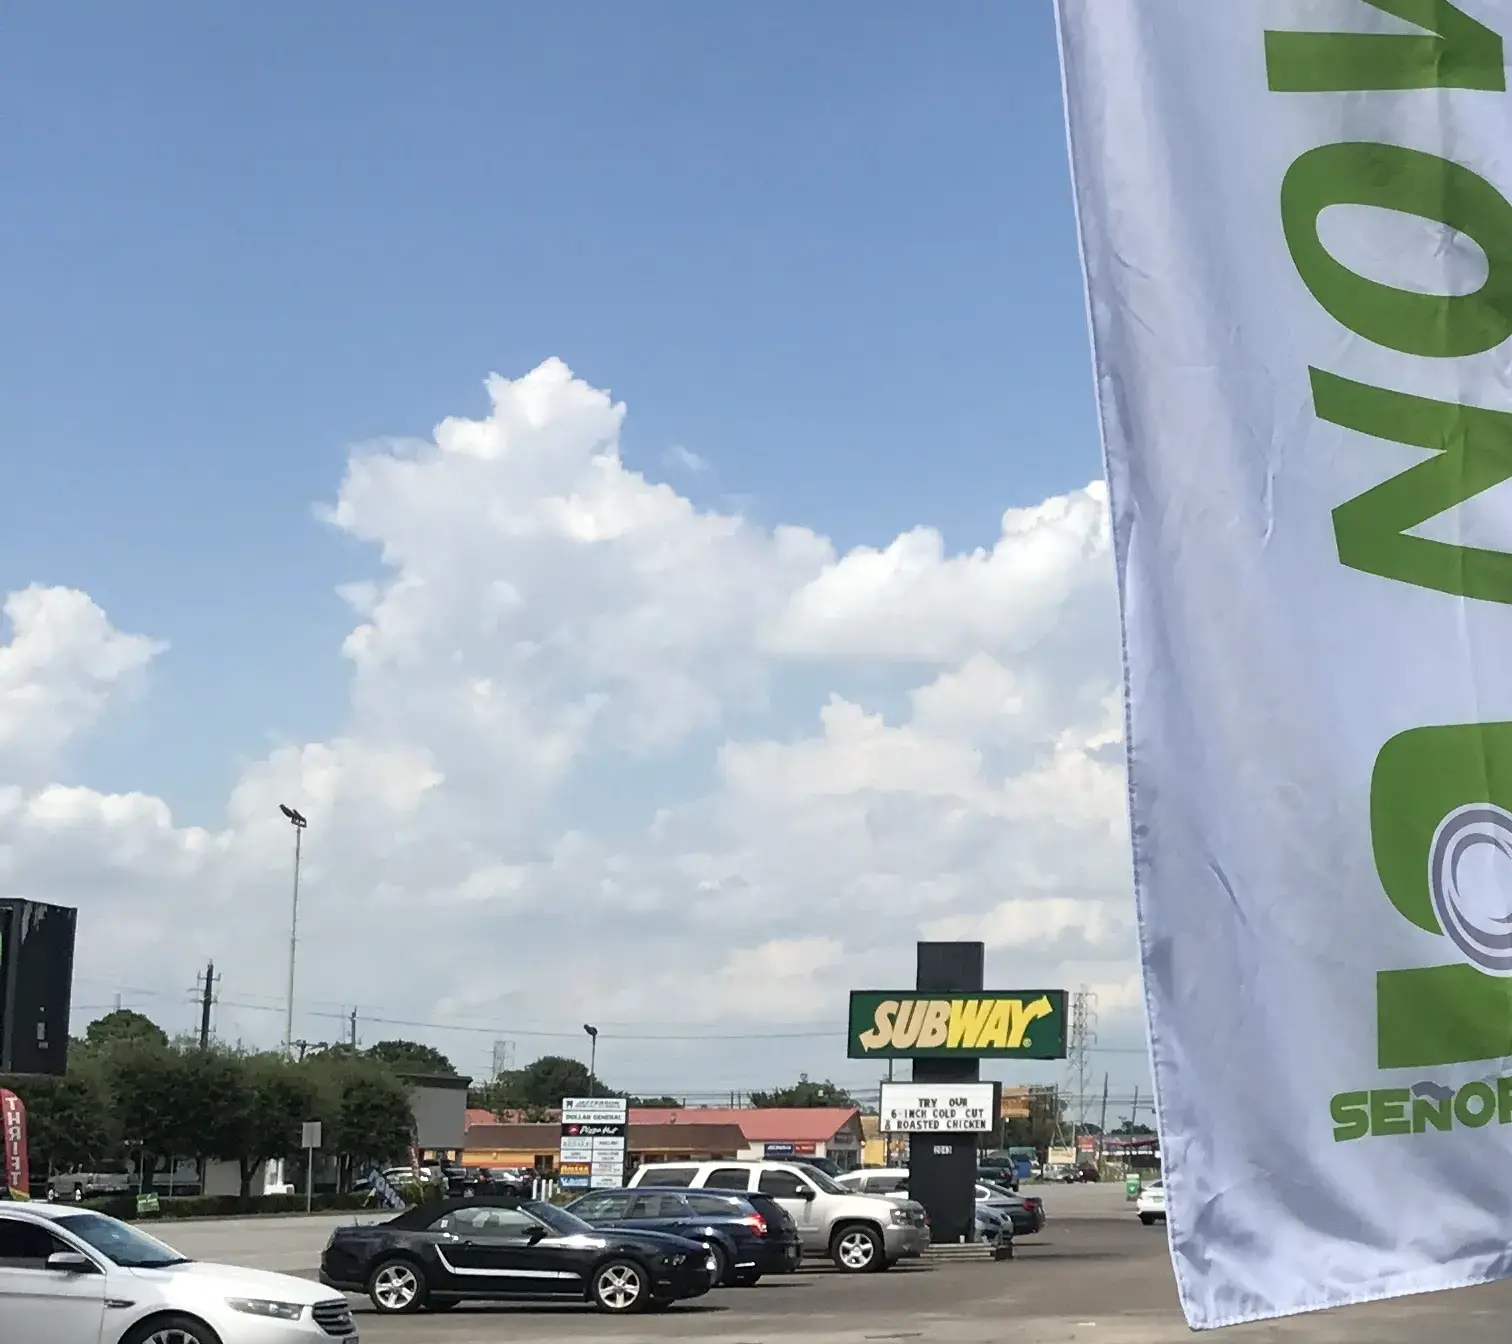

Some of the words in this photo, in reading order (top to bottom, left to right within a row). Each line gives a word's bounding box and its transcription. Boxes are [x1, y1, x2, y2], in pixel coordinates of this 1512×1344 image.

[859, 995, 1053, 1052] SUBWAY
[918, 1098, 938, 1107] TRY
[949, 1098, 968, 1107] OUR
[932, 1109, 957, 1118] COLD
[965, 1109, 984, 1118] CUT
[897, 1119, 939, 1129] ROASTED
[946, 1119, 986, 1129] CHICKEN
